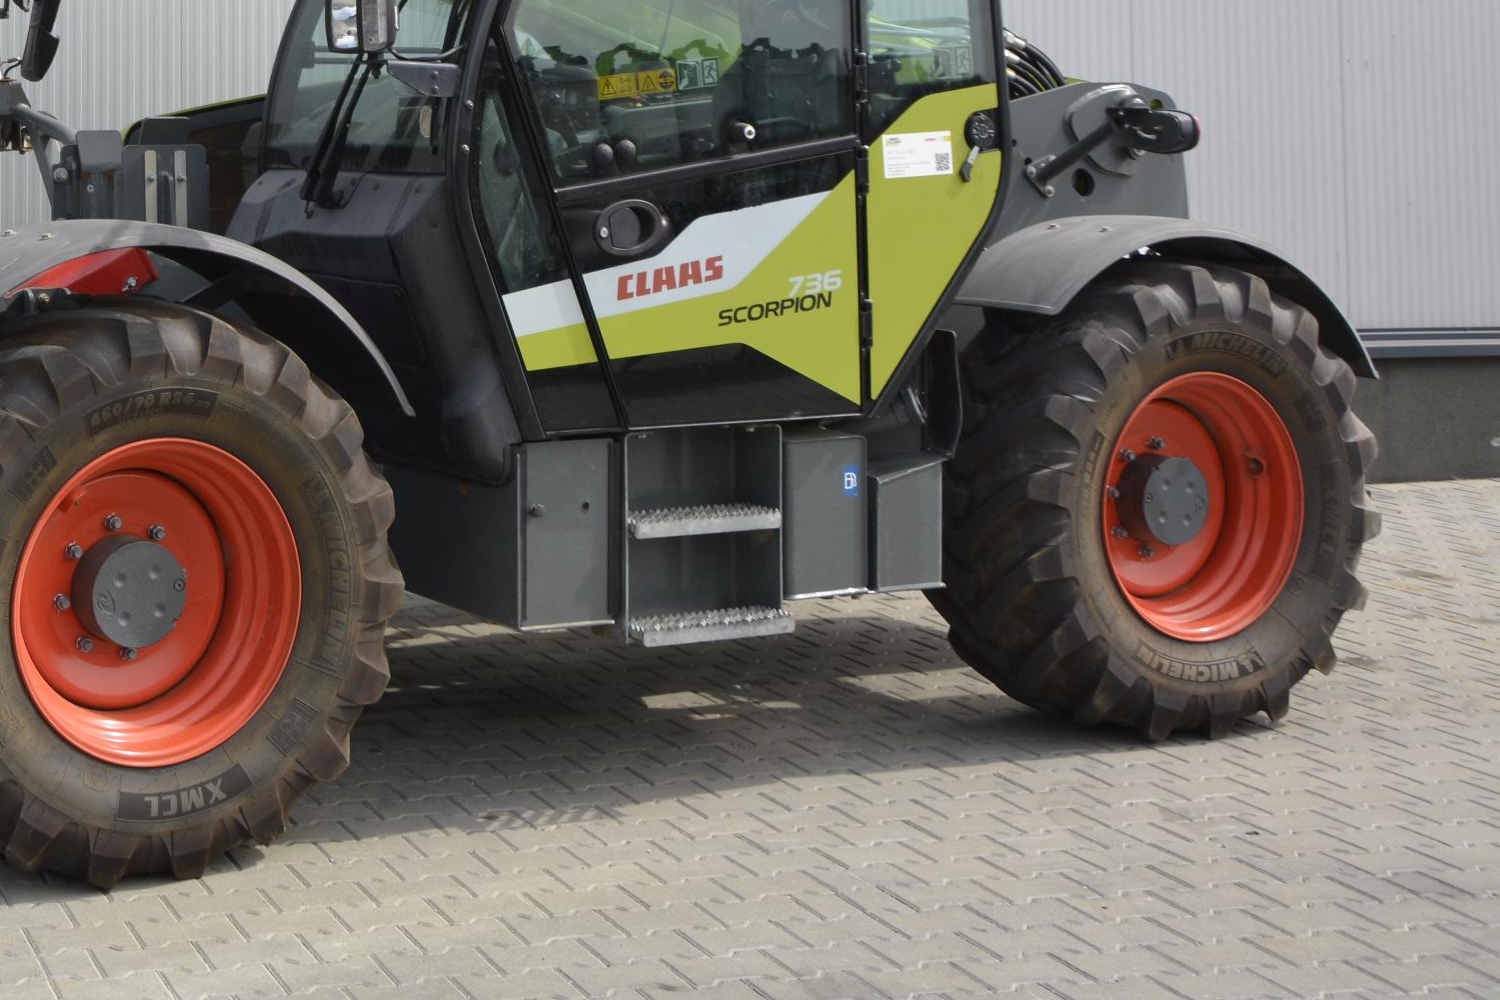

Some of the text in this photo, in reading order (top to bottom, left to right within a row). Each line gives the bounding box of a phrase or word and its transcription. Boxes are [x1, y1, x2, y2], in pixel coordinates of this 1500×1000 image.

[617, 255, 723, 301] CLAAS
[787, 269, 842, 299] 736
[718, 291, 833, 327] SCORPION
[1191, 332, 1286, 371] MICHELIN
[319, 512, 350, 665] MICHELIN
[1137, 645, 1240, 683] MICHELIN
[144, 777, 228, 818] XMCL
